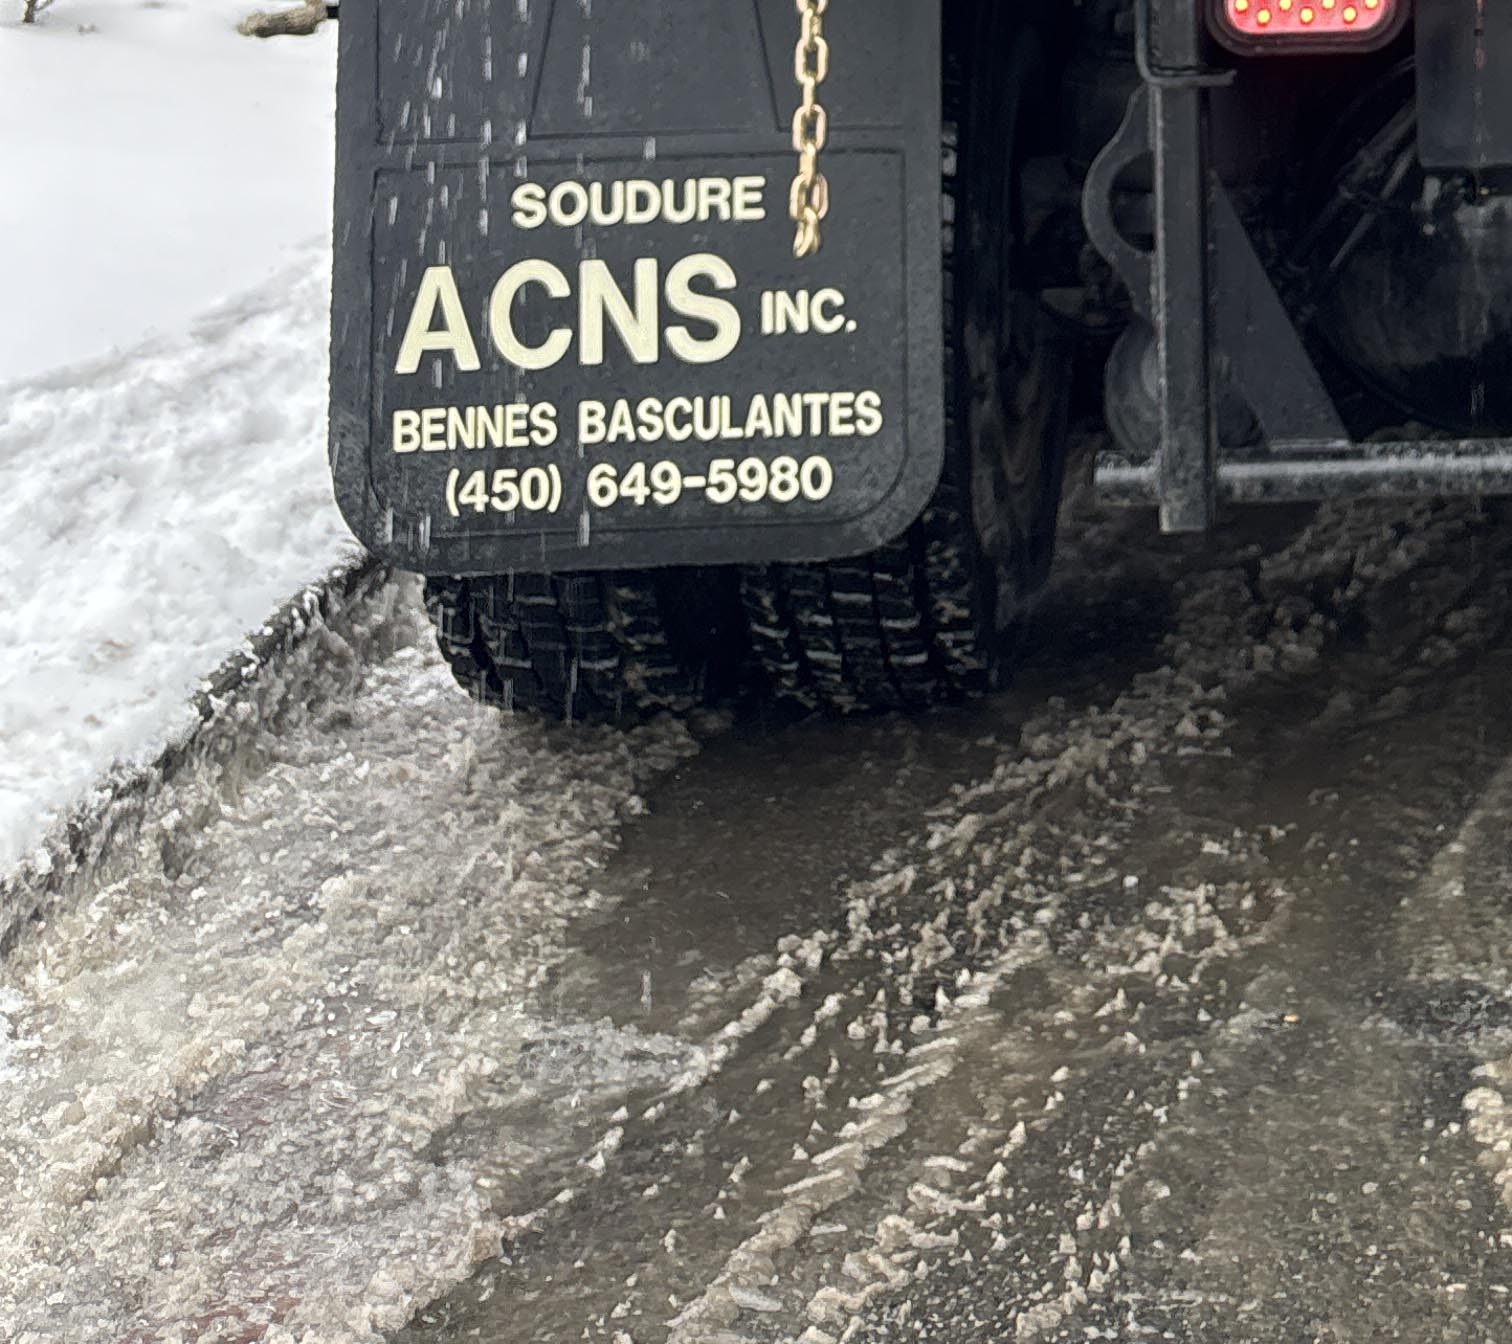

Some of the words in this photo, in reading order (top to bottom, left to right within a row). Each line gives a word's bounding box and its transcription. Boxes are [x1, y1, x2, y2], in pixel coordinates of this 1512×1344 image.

[512, 176, 765, 229] SOUDURE
[395, 253, 741, 375] ACNS
[761, 288, 858, 335] INC.
[392, 402, 557, 453] BENNES
[578, 391, 883, 445] BASCULANTES
[446, 464, 562, 517] (450)
[587, 455, 833, 507] 649-5980
